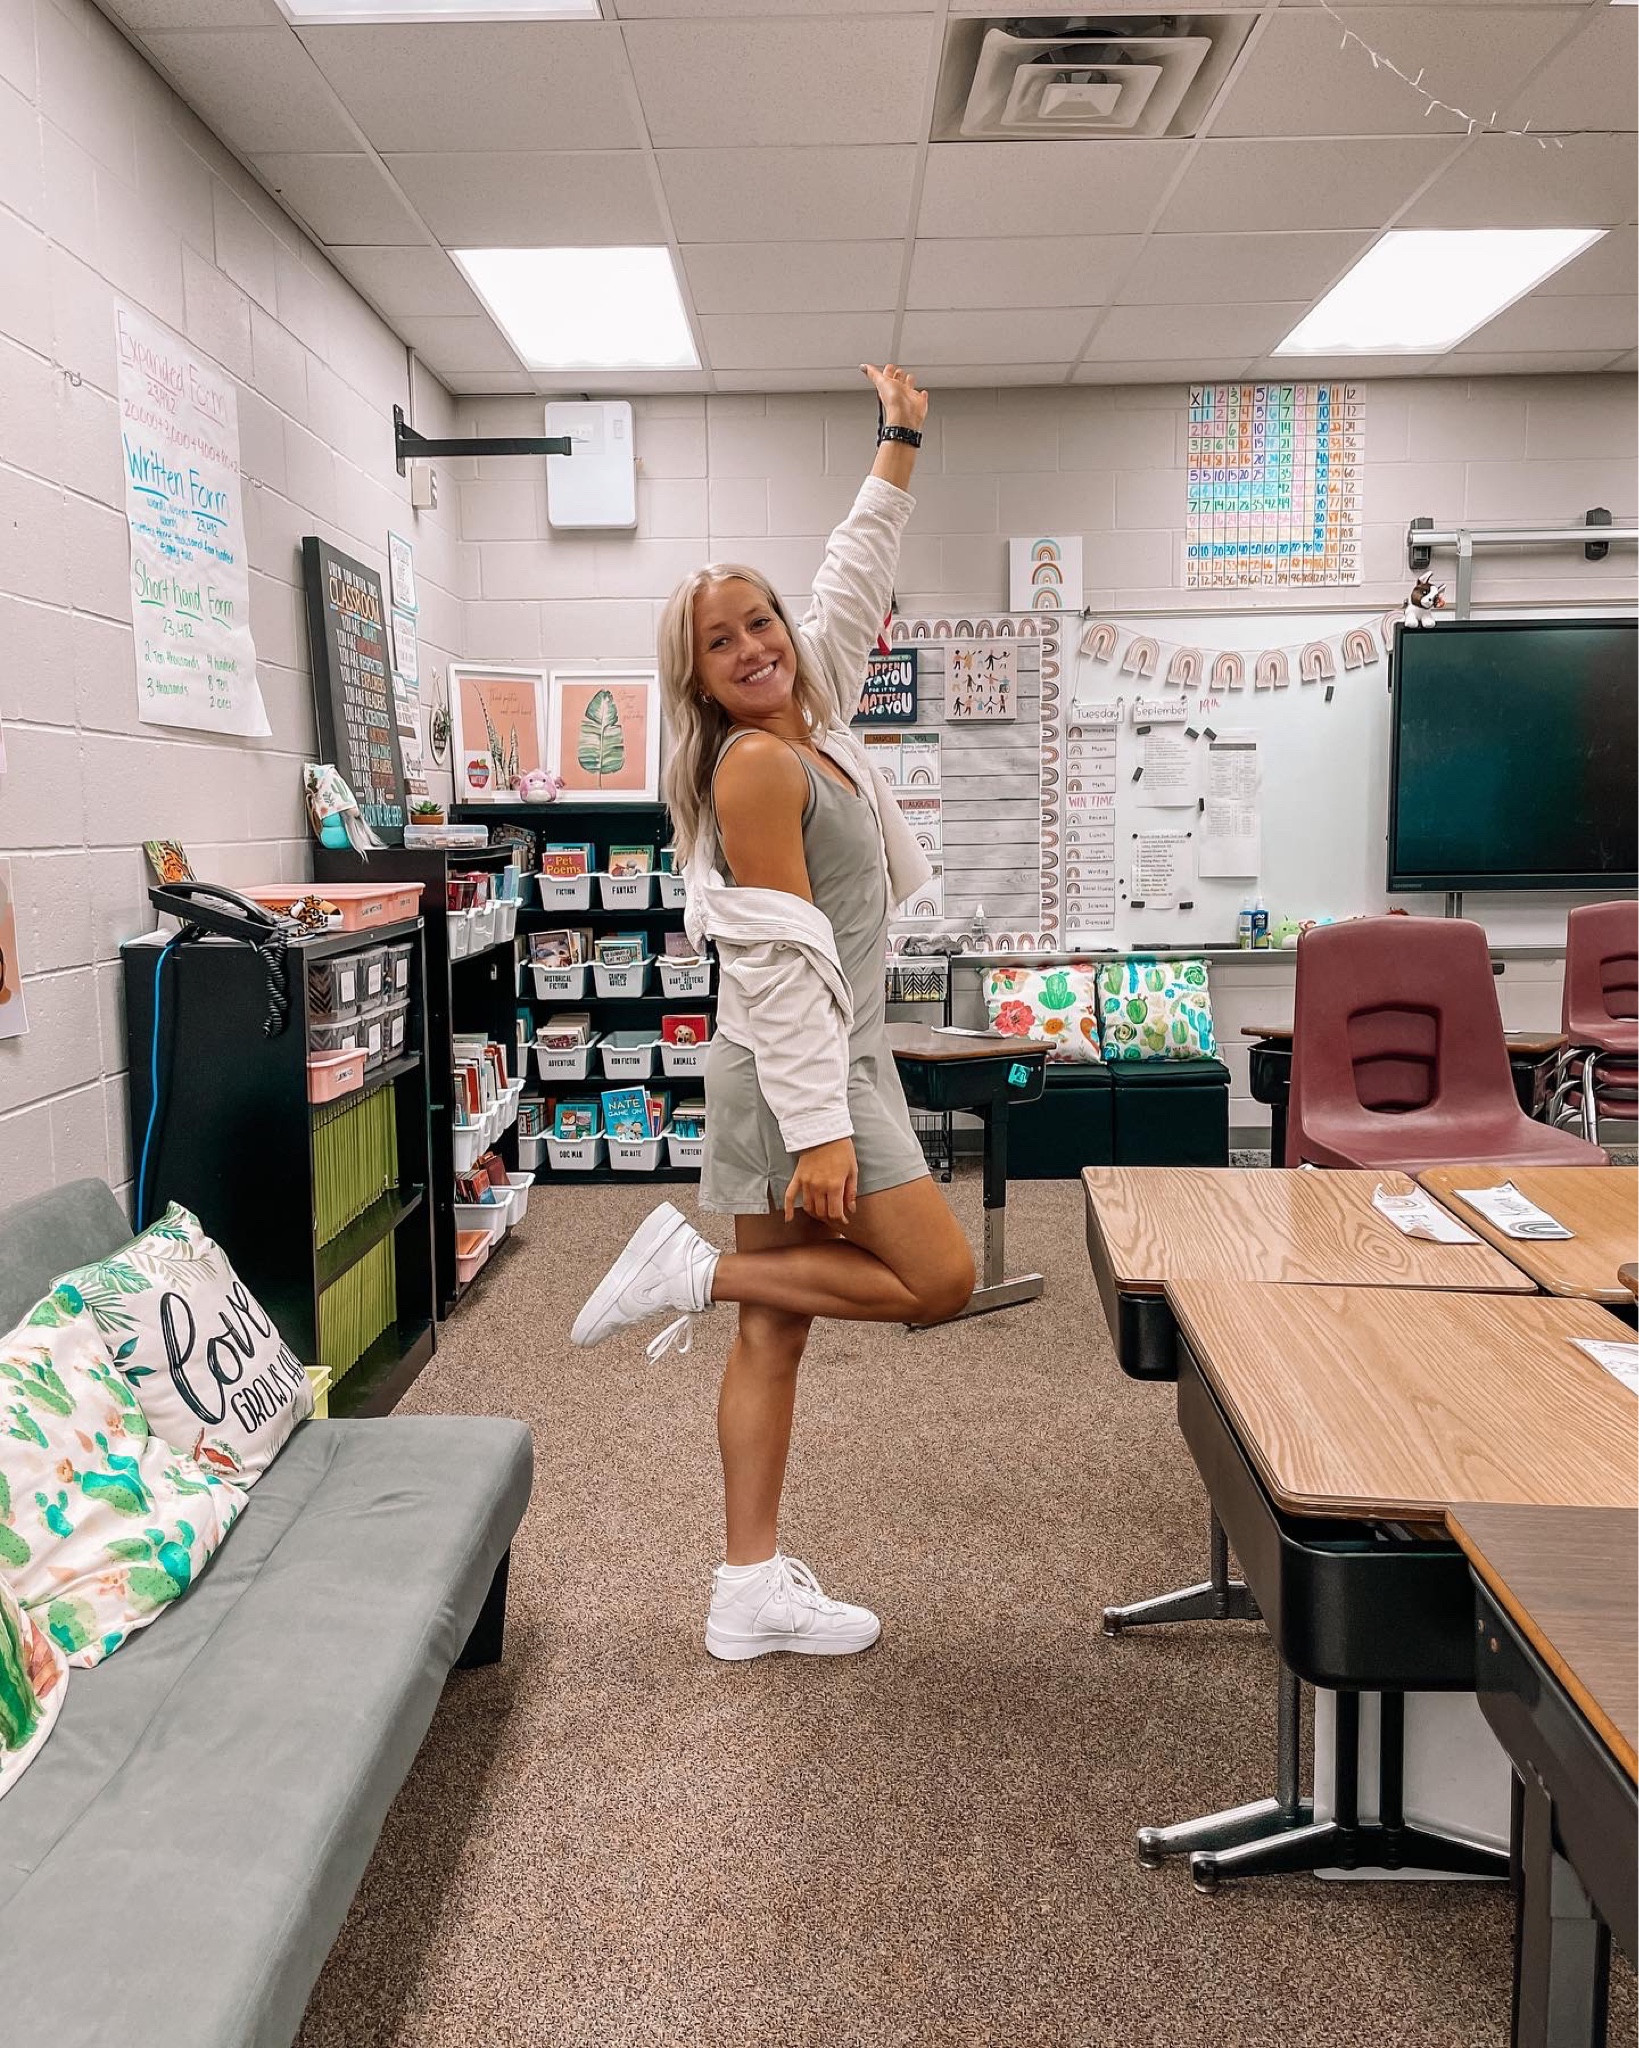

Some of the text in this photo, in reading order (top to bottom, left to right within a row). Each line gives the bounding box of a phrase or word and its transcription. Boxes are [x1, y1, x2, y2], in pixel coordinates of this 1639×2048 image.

[118, 310, 228, 421] Expanded Form
[1191, 387, 1356, 406] X 2 3 4 5 6 7 10 12
[1256, 406, 1356, 419] 5 7 10 12
[1254, 422, 1291, 435] 10 14
[1254, 438, 1290, 449] 15 21
[1281, 452, 1356, 463] 28 48
[123, 433, 229, 514] Written Form
[1190, 468, 1355, 481] 5 5 10 15 25 35 60
[1317, 483, 1355, 494] 60 72
[1189, 497, 1354, 512] 7 7 14 28 84
[1342, 512, 1354, 522] 96
[1188, 544, 1355, 558] 10 10 60 70 120
[1341, 558, 1354, 568] 132
[1188, 573, 1355, 586] 12 72 84 144
[135, 559, 234, 617] Short hand Form
[329, 576, 381, 625] CLASSROOM
[163, 616, 194, 639] 23,482
[867, 662, 900, 677] APPEN
[882, 662, 912, 686] YOU
[858, 693, 901, 715] MATTER
[885, 692, 912, 715] YOU
[1076, 709, 1119, 720] Tuesday
[1136, 704, 1187, 718] September
[1068, 796, 1114, 808] WIN TIME
[556, 856, 572, 865] Pet
[546, 865, 581, 874] Poems
[612, 886, 637, 894] FANTASY
[548, 1059, 576, 1067] ADVENTURE
[673, 1057, 696, 1065] ANIMALS
[608, 1098, 641, 1109] NATE
[572, 1150, 583, 1158] MAN
[159, 1281, 271, 1425] love
[231, 1363, 293, 1434] GROWS
